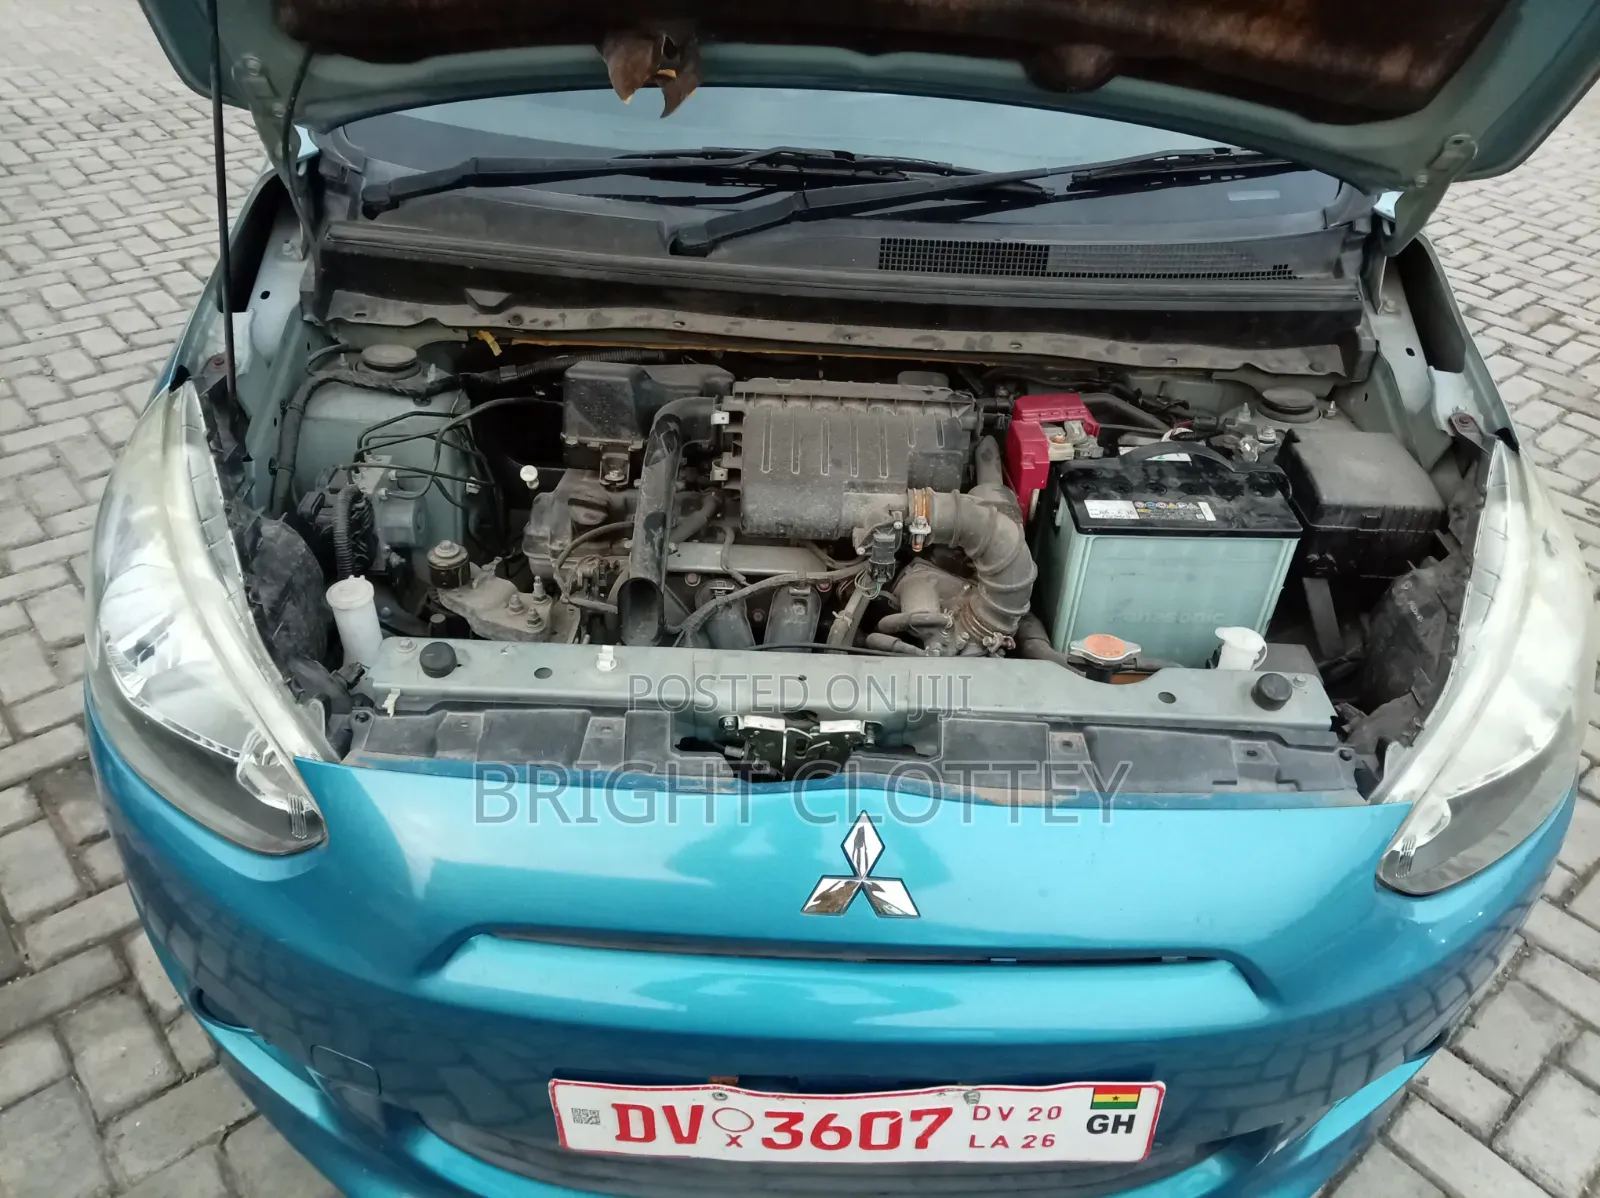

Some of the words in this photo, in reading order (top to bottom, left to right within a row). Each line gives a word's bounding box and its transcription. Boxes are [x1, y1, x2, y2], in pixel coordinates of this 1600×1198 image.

[973, 1105, 1015, 1121] DV
[1028, 1106, 1063, 1122] 20
[611, 1103, 705, 1145] DV
[761, 1107, 954, 1152] 3607
[1086, 1114, 1136, 1135] GH
[968, 1134, 1010, 1149] LA
[1020, 1134, 1056, 1149] 26
